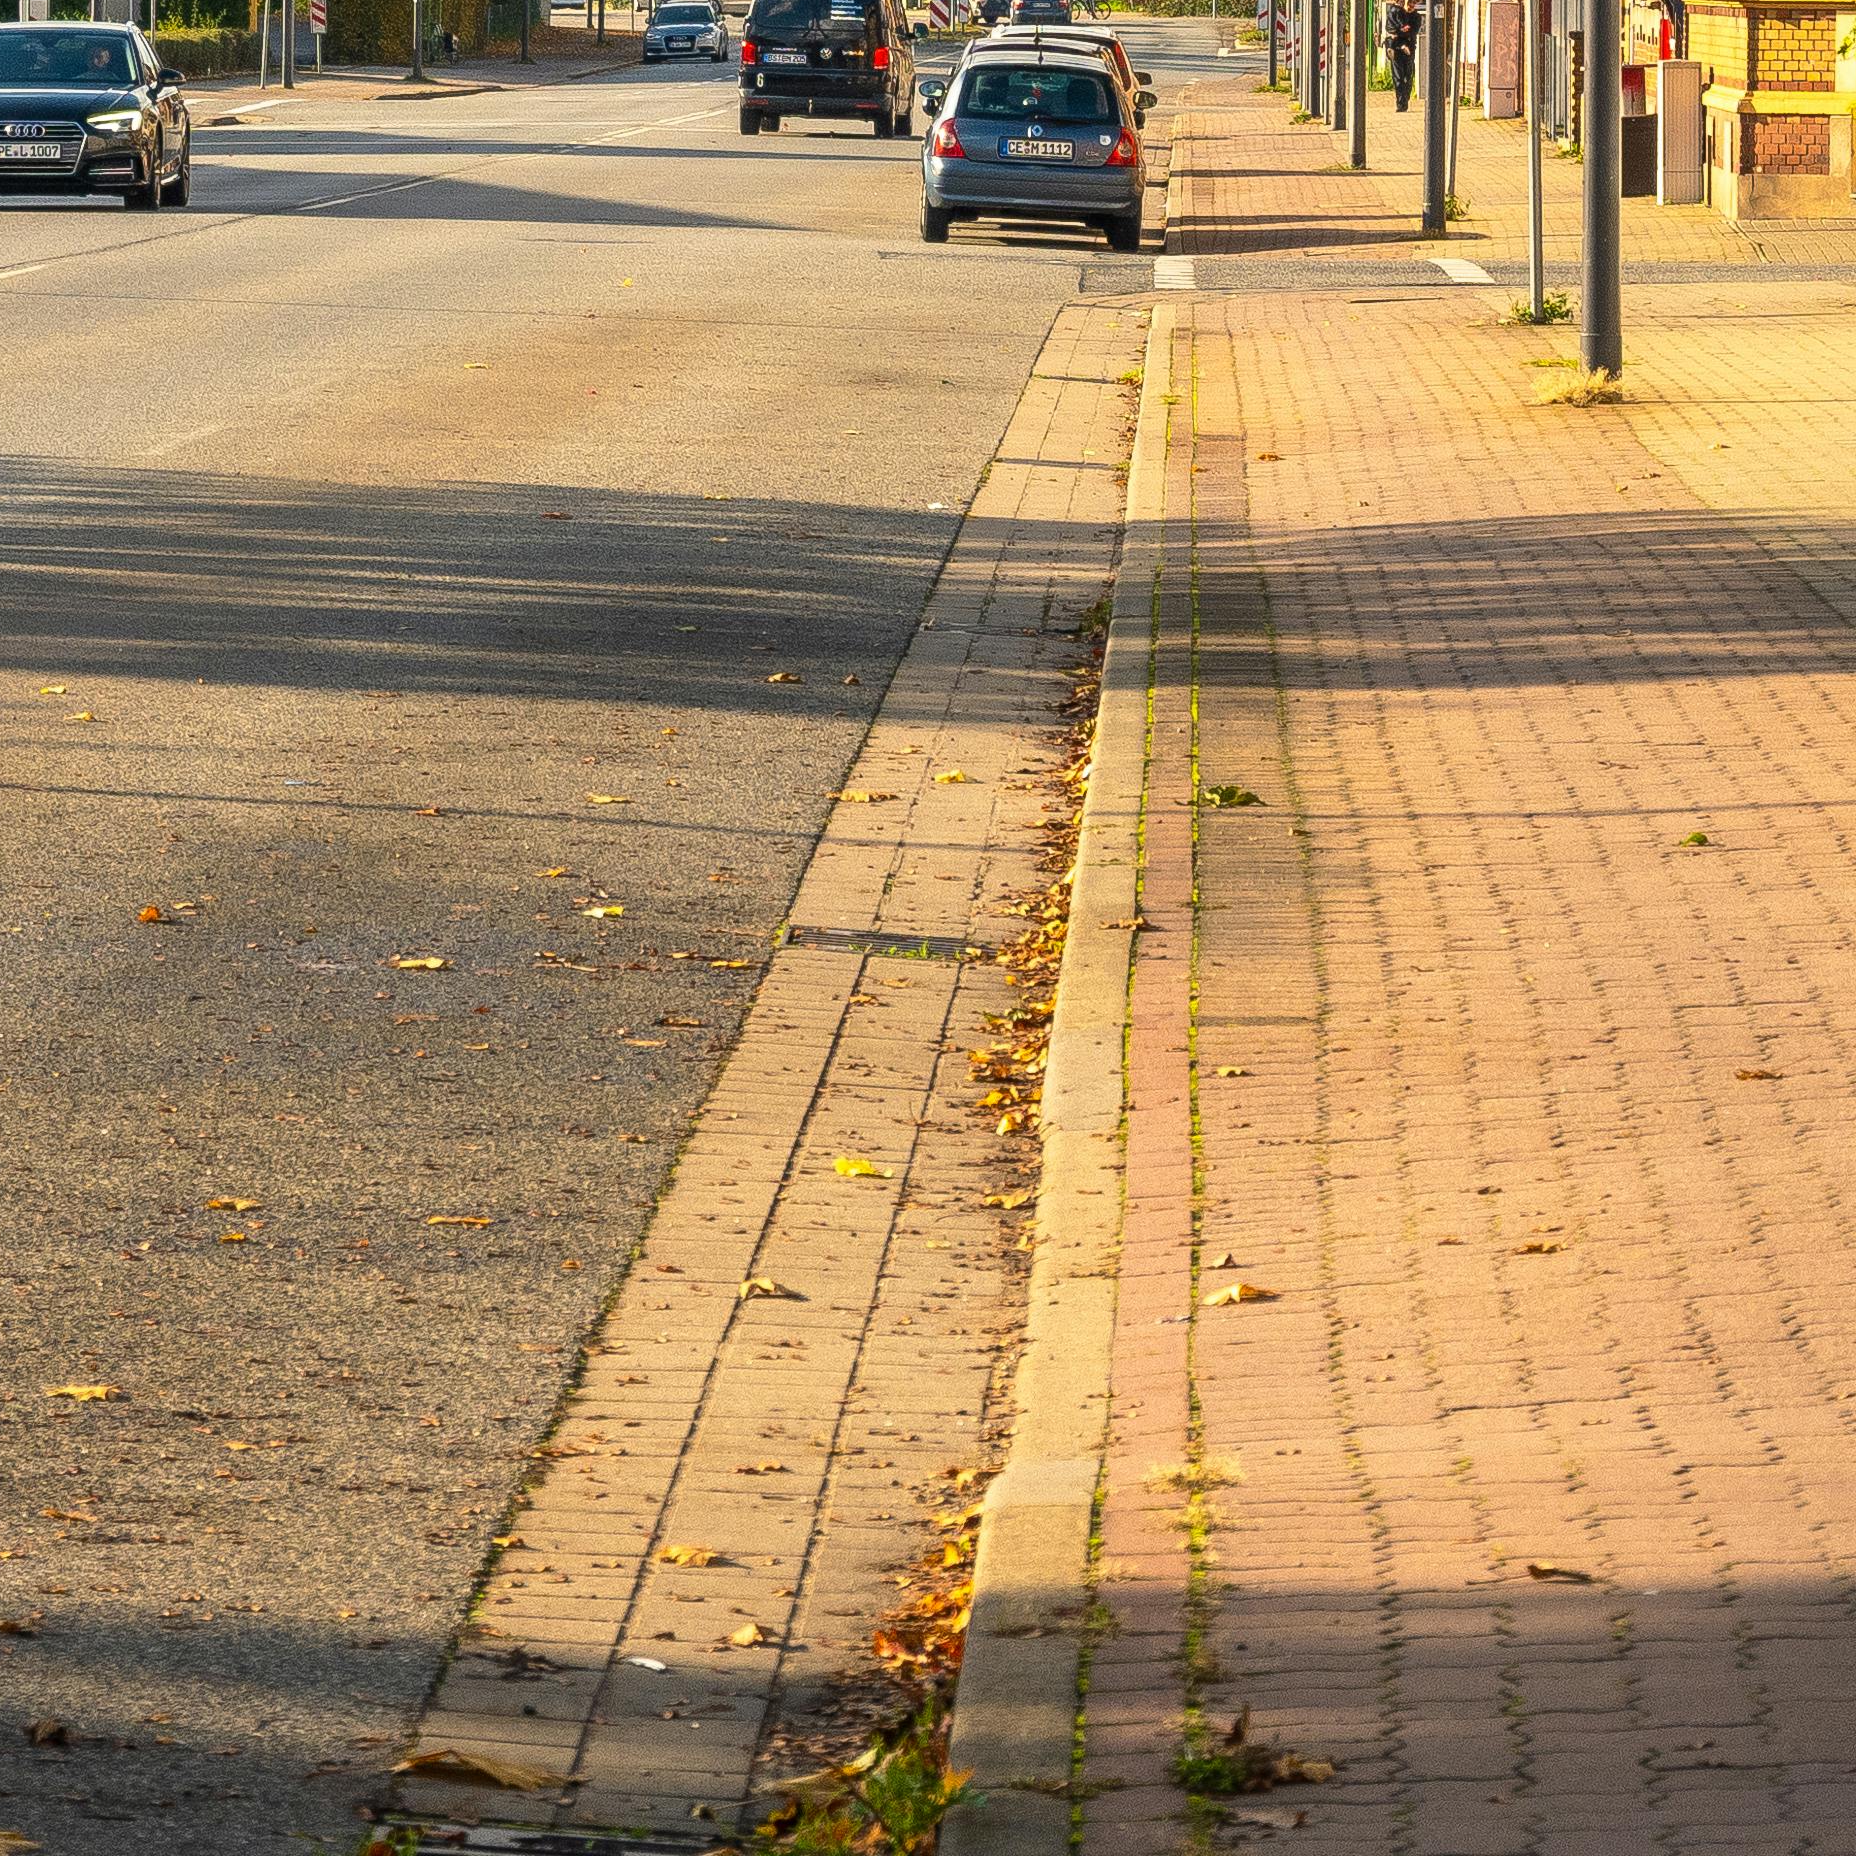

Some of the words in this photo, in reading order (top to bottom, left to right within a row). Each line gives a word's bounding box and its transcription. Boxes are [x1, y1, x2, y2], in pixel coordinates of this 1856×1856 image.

[30, 145, 59, 157] 1007
[1008, 141, 1023, 153] CE
[1031, 143, 1039, 154] M
[1041, 144, 1071, 156] 1112
